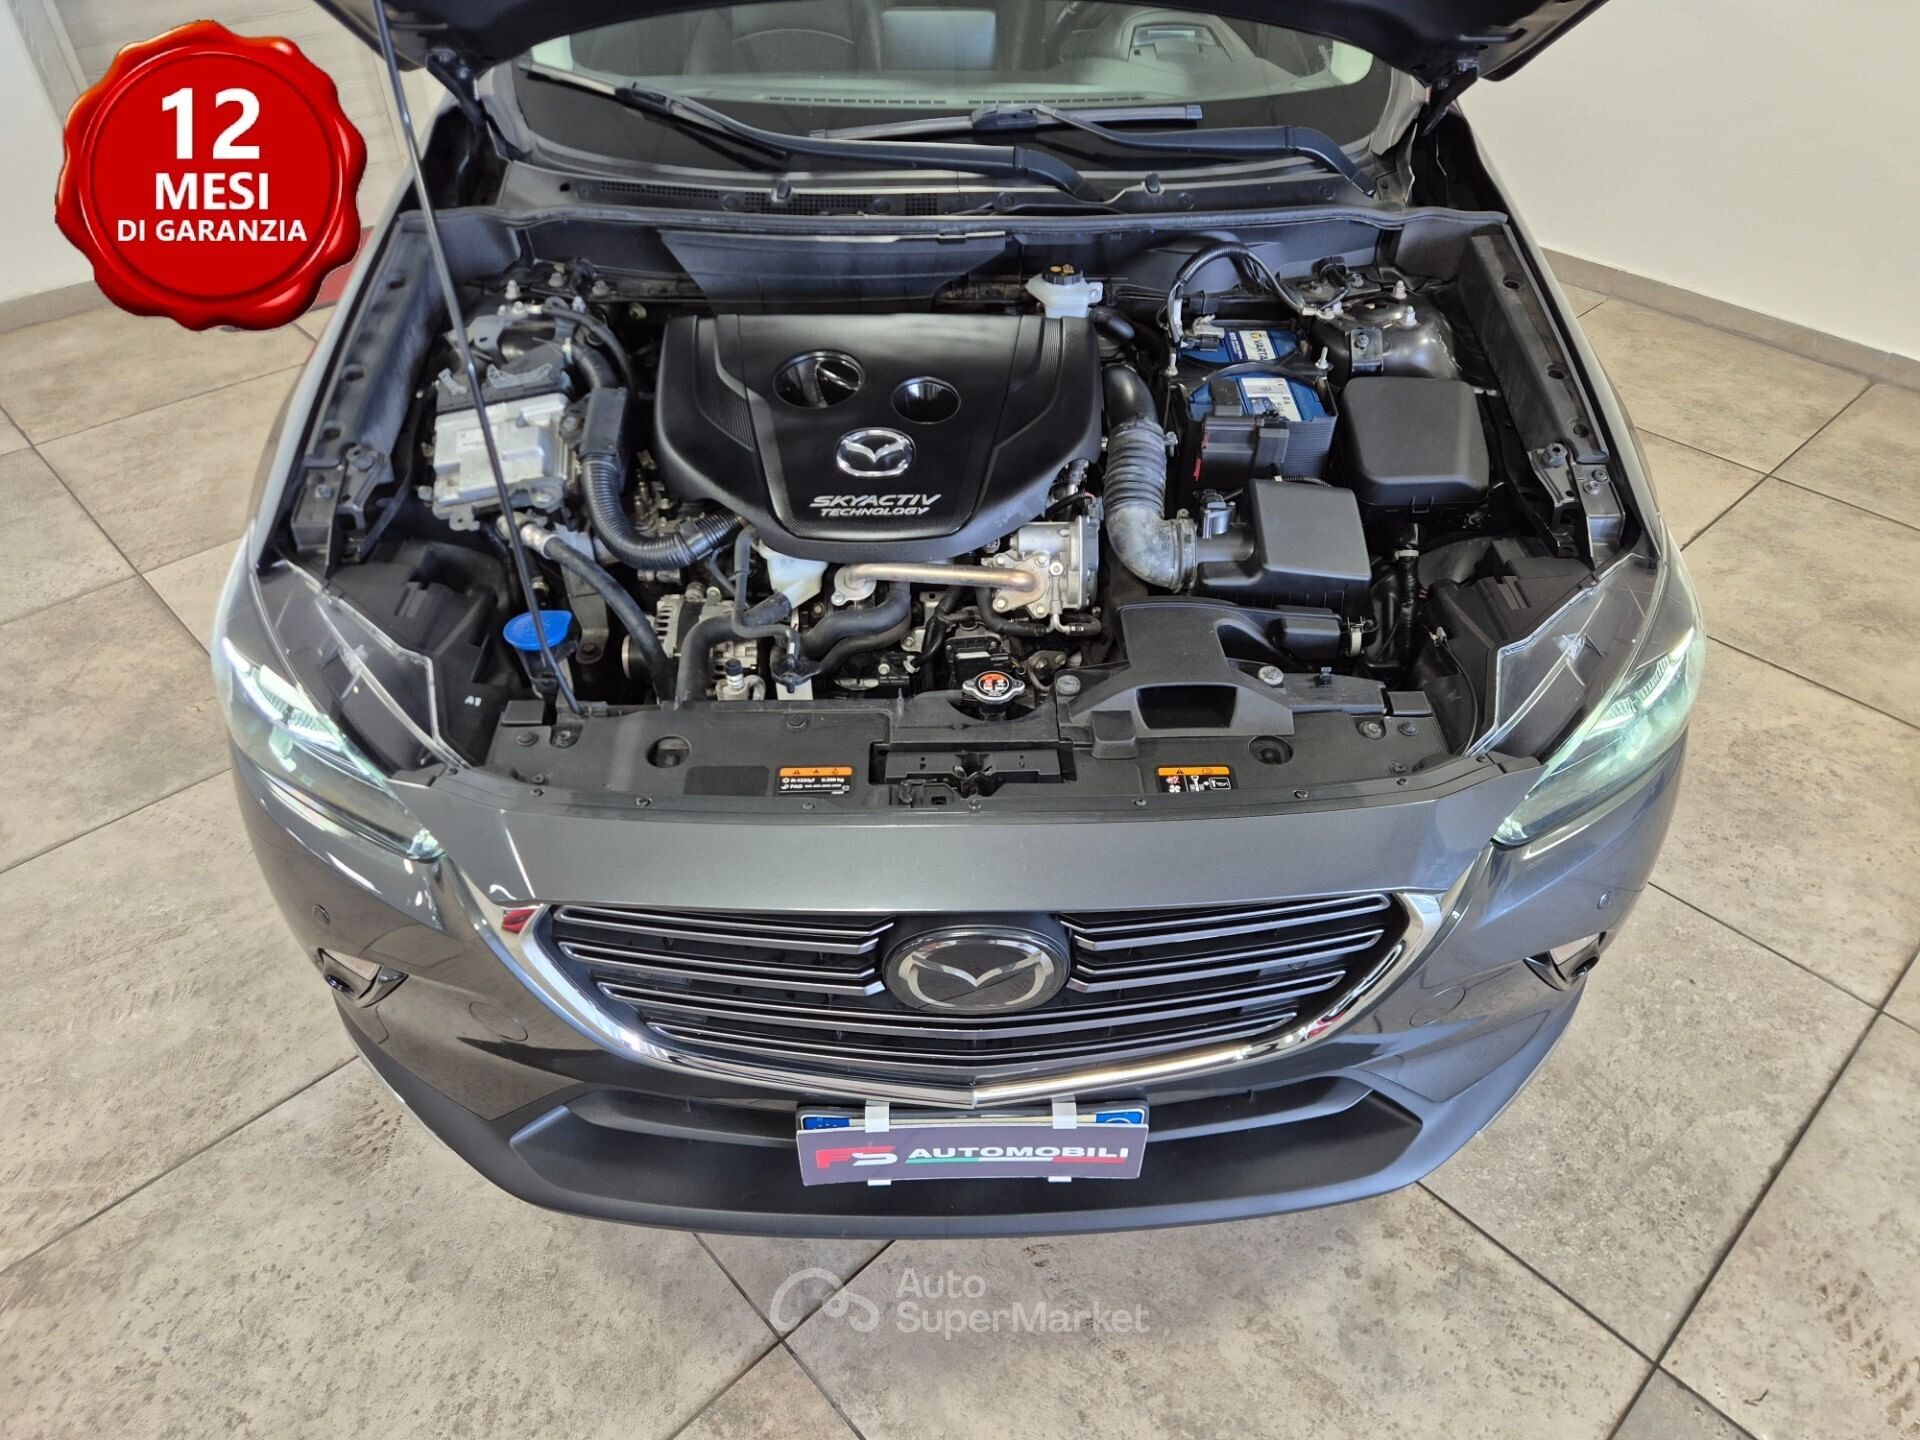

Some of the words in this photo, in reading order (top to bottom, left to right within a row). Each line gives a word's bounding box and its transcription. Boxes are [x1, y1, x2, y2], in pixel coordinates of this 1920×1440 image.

[809, 494, 942, 507] SKYACTIV
[820, 507, 930, 517] TECHNOLOGY
[908, 1146, 1129, 1159] AUTOMOBILI
